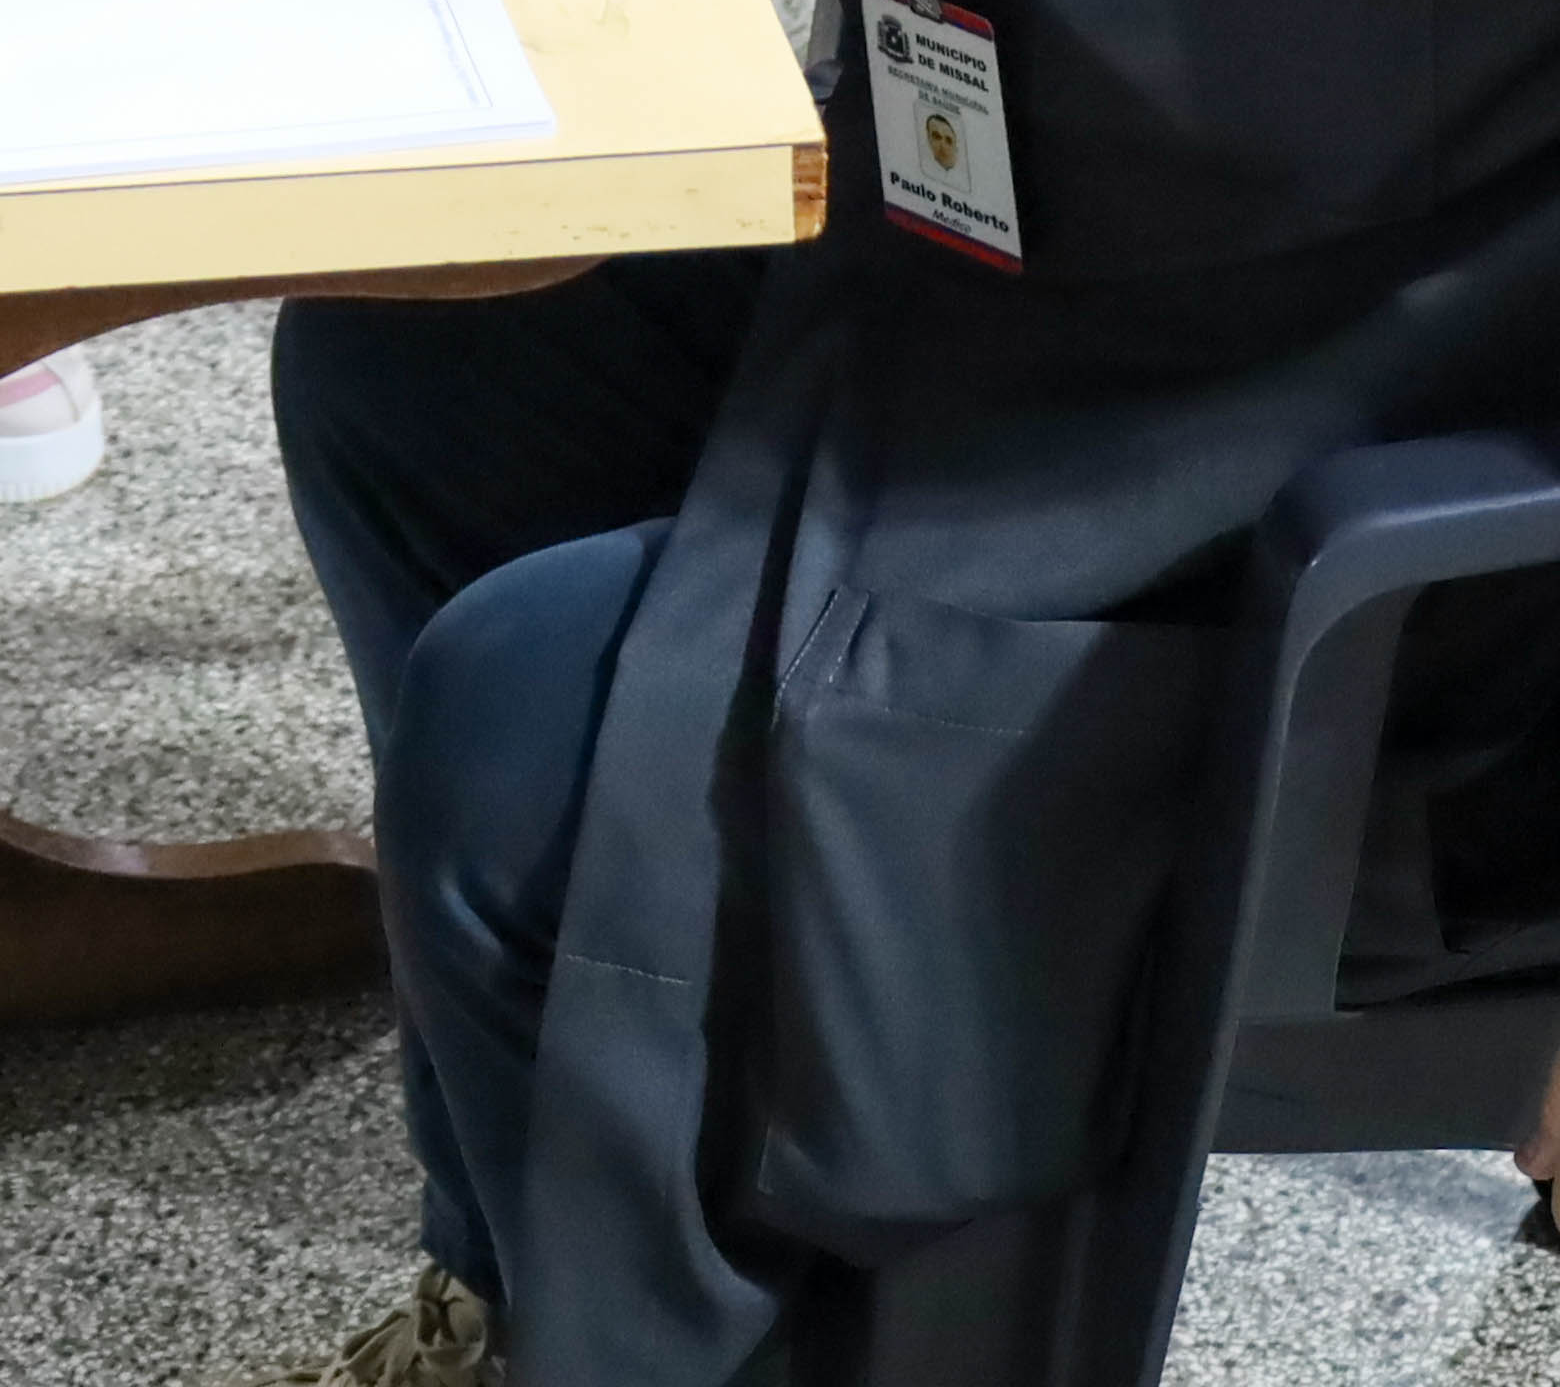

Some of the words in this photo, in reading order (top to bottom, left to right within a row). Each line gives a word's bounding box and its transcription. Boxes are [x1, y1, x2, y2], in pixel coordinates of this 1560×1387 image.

[918, 53, 935, 69] DE
[939, 62, 989, 93] MISSAL
[890, 171, 937, 203] Paulo
[941, 190, 1010, 234] Roberto
